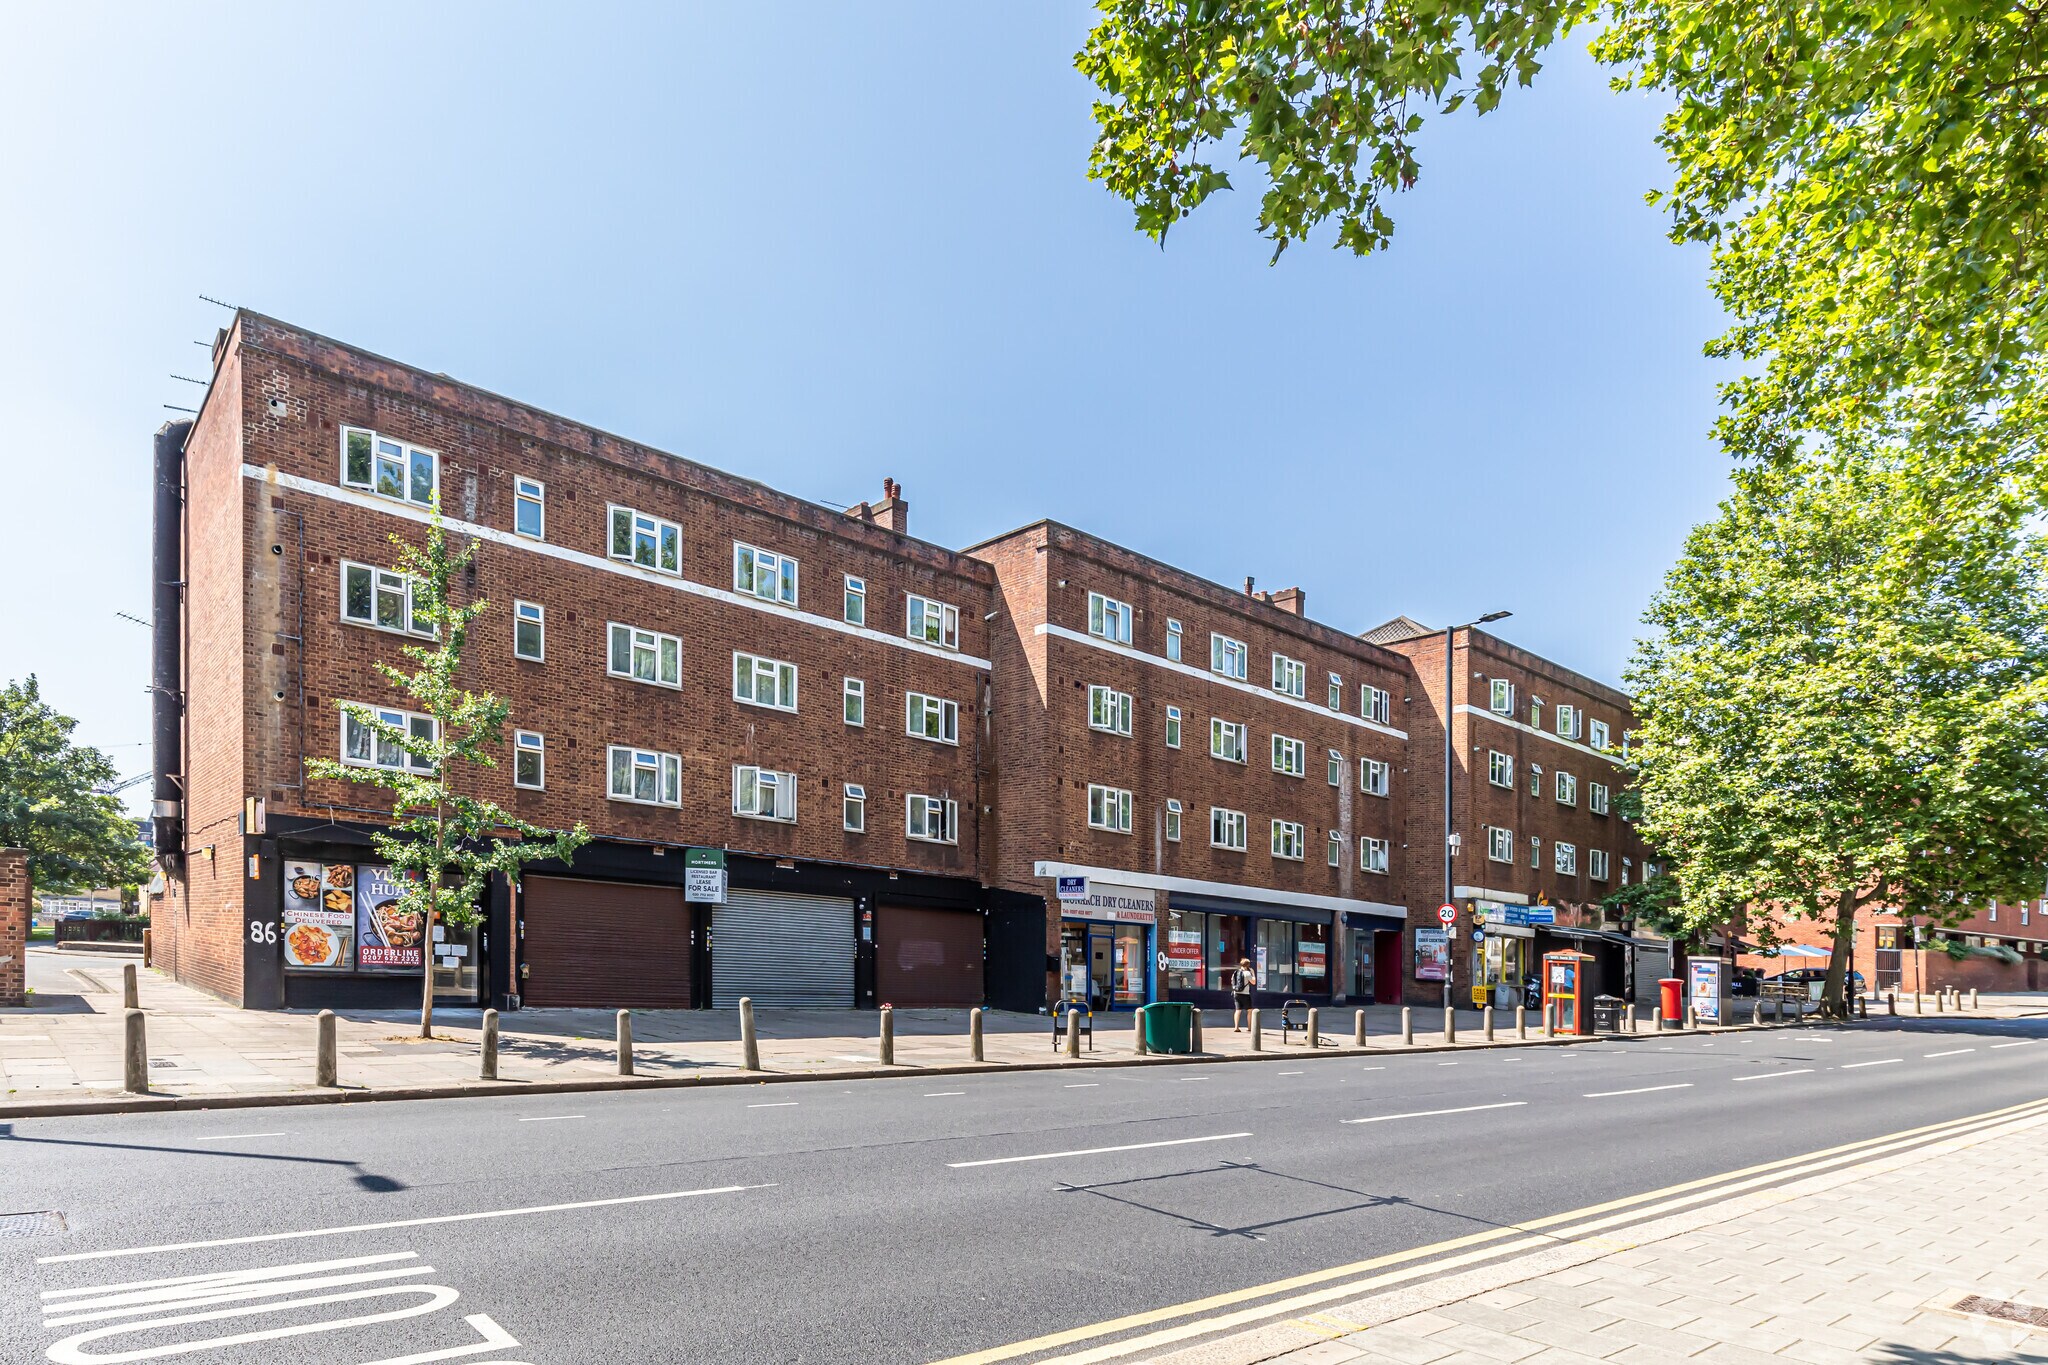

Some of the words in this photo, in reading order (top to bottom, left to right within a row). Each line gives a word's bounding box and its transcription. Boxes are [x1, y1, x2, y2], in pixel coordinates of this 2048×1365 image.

[1060, 885, 1084, 893] CLEANERS
[1103, 896, 1117, 908] DRY
[1118, 898, 1154, 912] CLEANERS
[286, 910, 325, 919] CHINESE
[1121, 911, 1154, 921] LAUNDERETTE
[1440, 910, 1454, 918] 20
[295, 917, 342, 925] DELIVERED
[250, 920, 277, 945] 86
[362, 948, 419, 957] ORDERLINE
